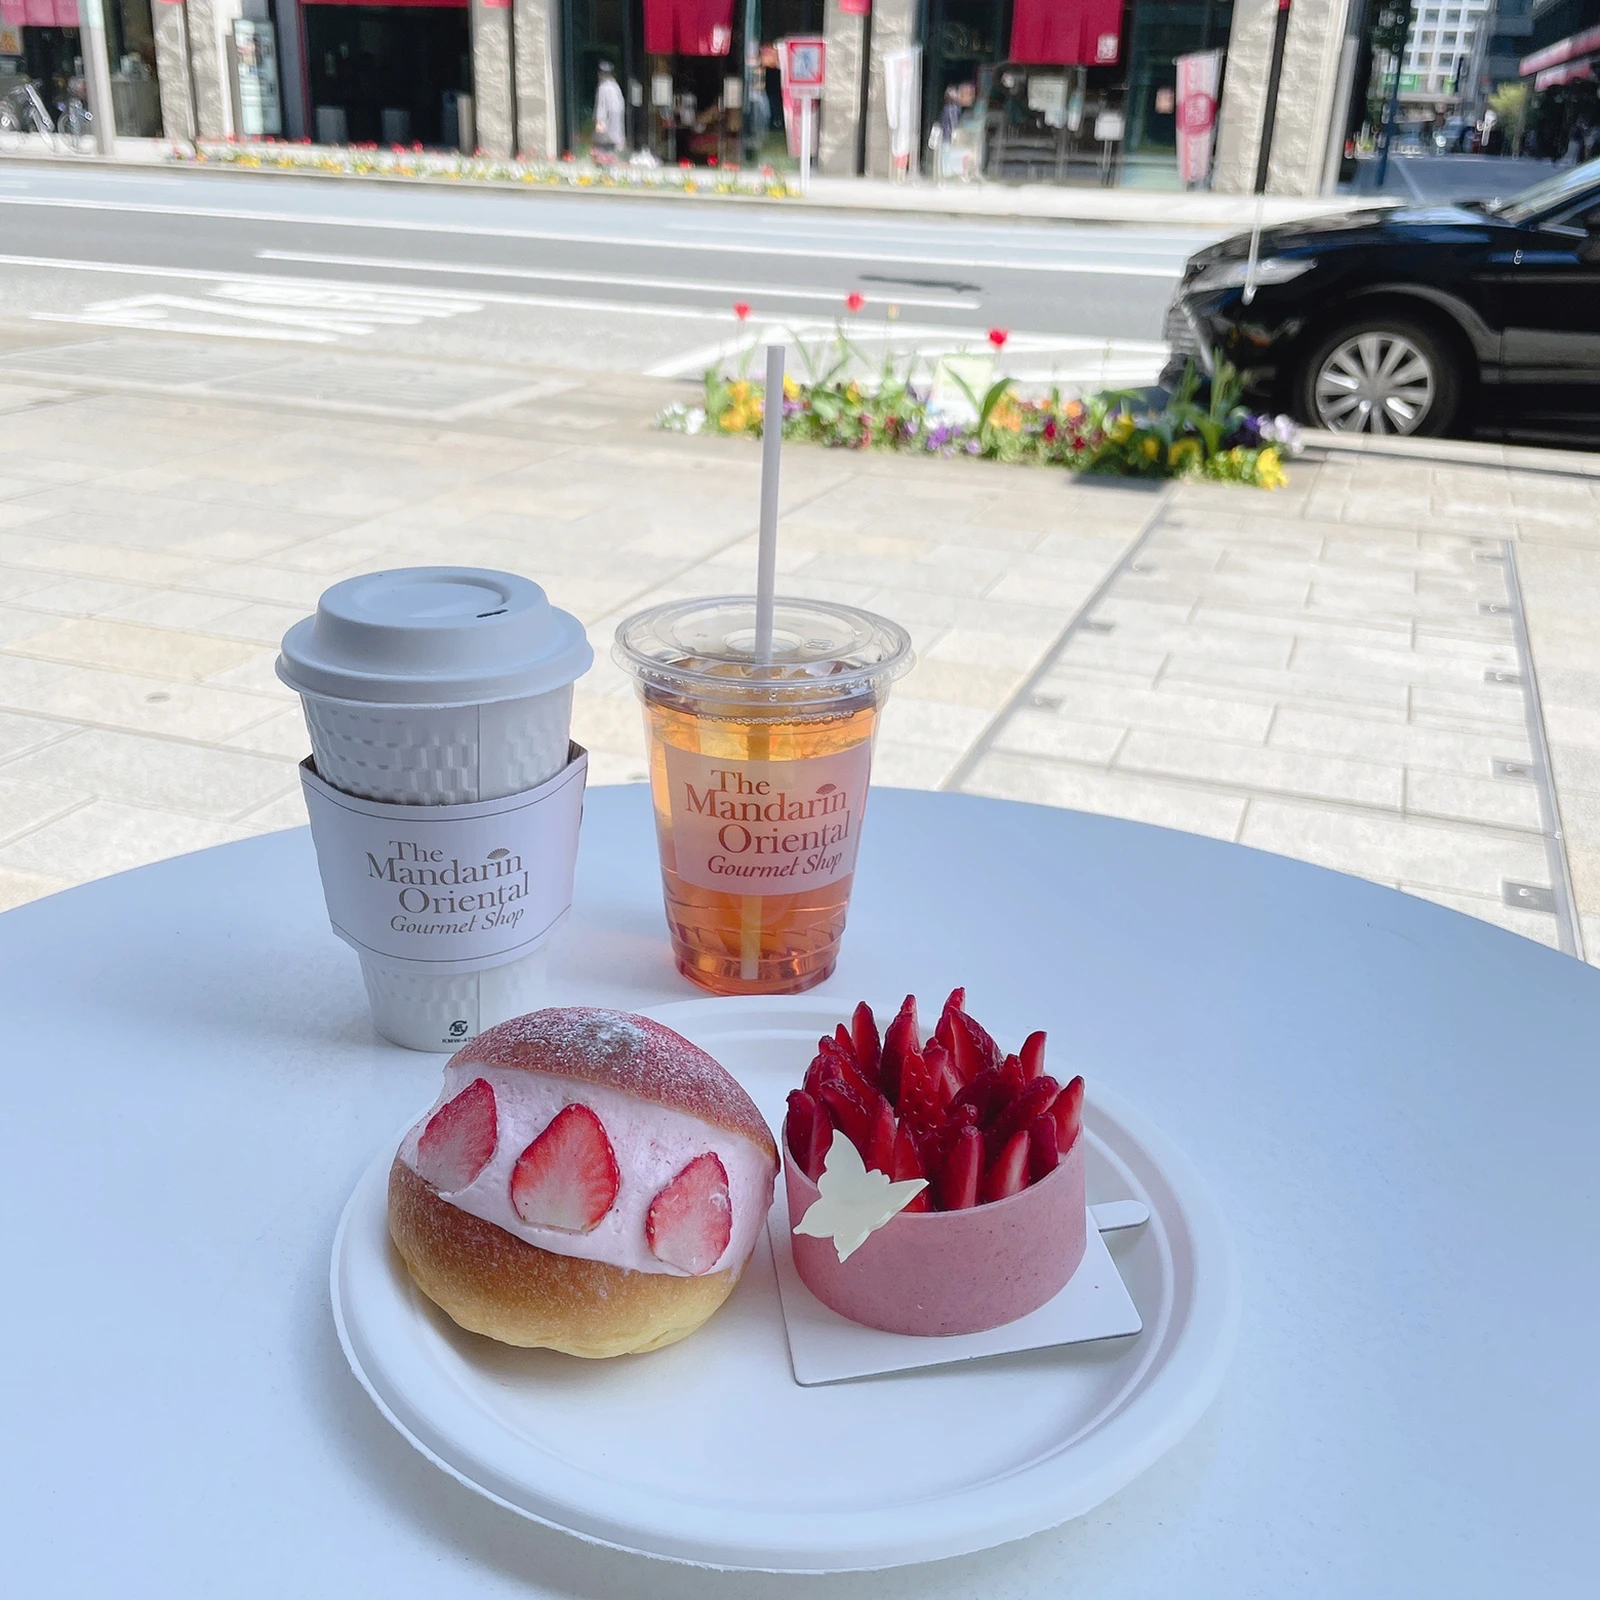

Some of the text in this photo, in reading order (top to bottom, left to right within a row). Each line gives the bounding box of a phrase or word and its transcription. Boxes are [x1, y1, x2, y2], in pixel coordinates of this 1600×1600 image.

[711, 769, 770, 795] The
[684, 781, 847, 823] Mandarin
[718, 810, 851, 854] Oriental
[389, 840, 444, 862] The
[707, 846, 843, 878] Gourmet Shop
[365, 851, 523, 886] Mandarin
[399, 871, 530, 914] Oriental
[390, 905, 524, 934] Gourmet Shop
